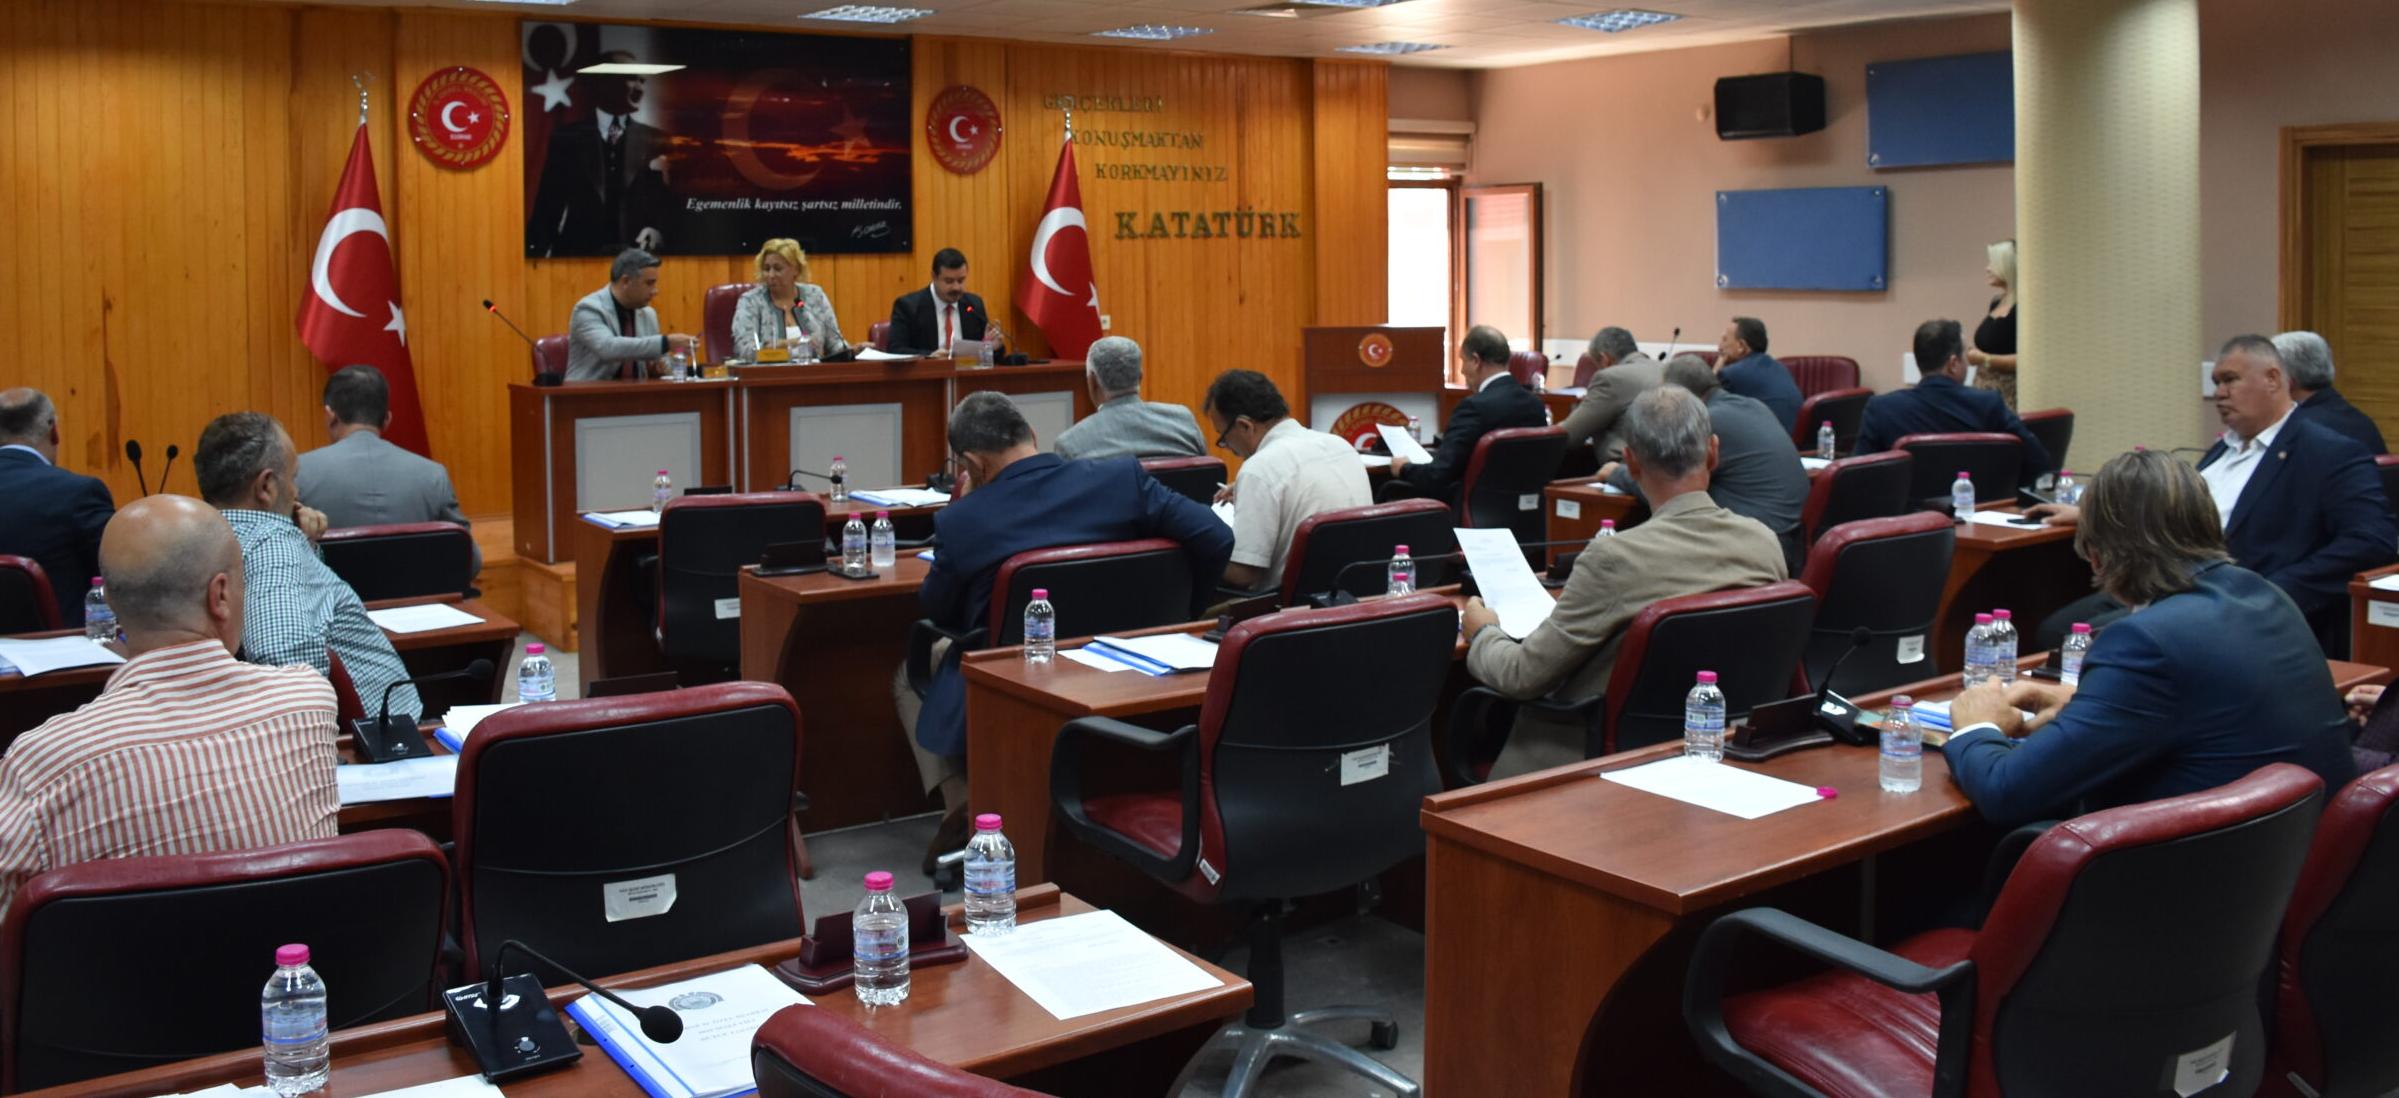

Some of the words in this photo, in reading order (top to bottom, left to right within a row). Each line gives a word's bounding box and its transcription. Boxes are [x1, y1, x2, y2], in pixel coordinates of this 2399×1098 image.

[1096, 163, 1228, 182] KORKMAYINIZ
[686, 197, 751, 212] Egemenlik
[754, 197, 799, 212] kayıtsız
[801, 199, 839, 212] şartsız
[840, 198, 902, 210] milletindir.
